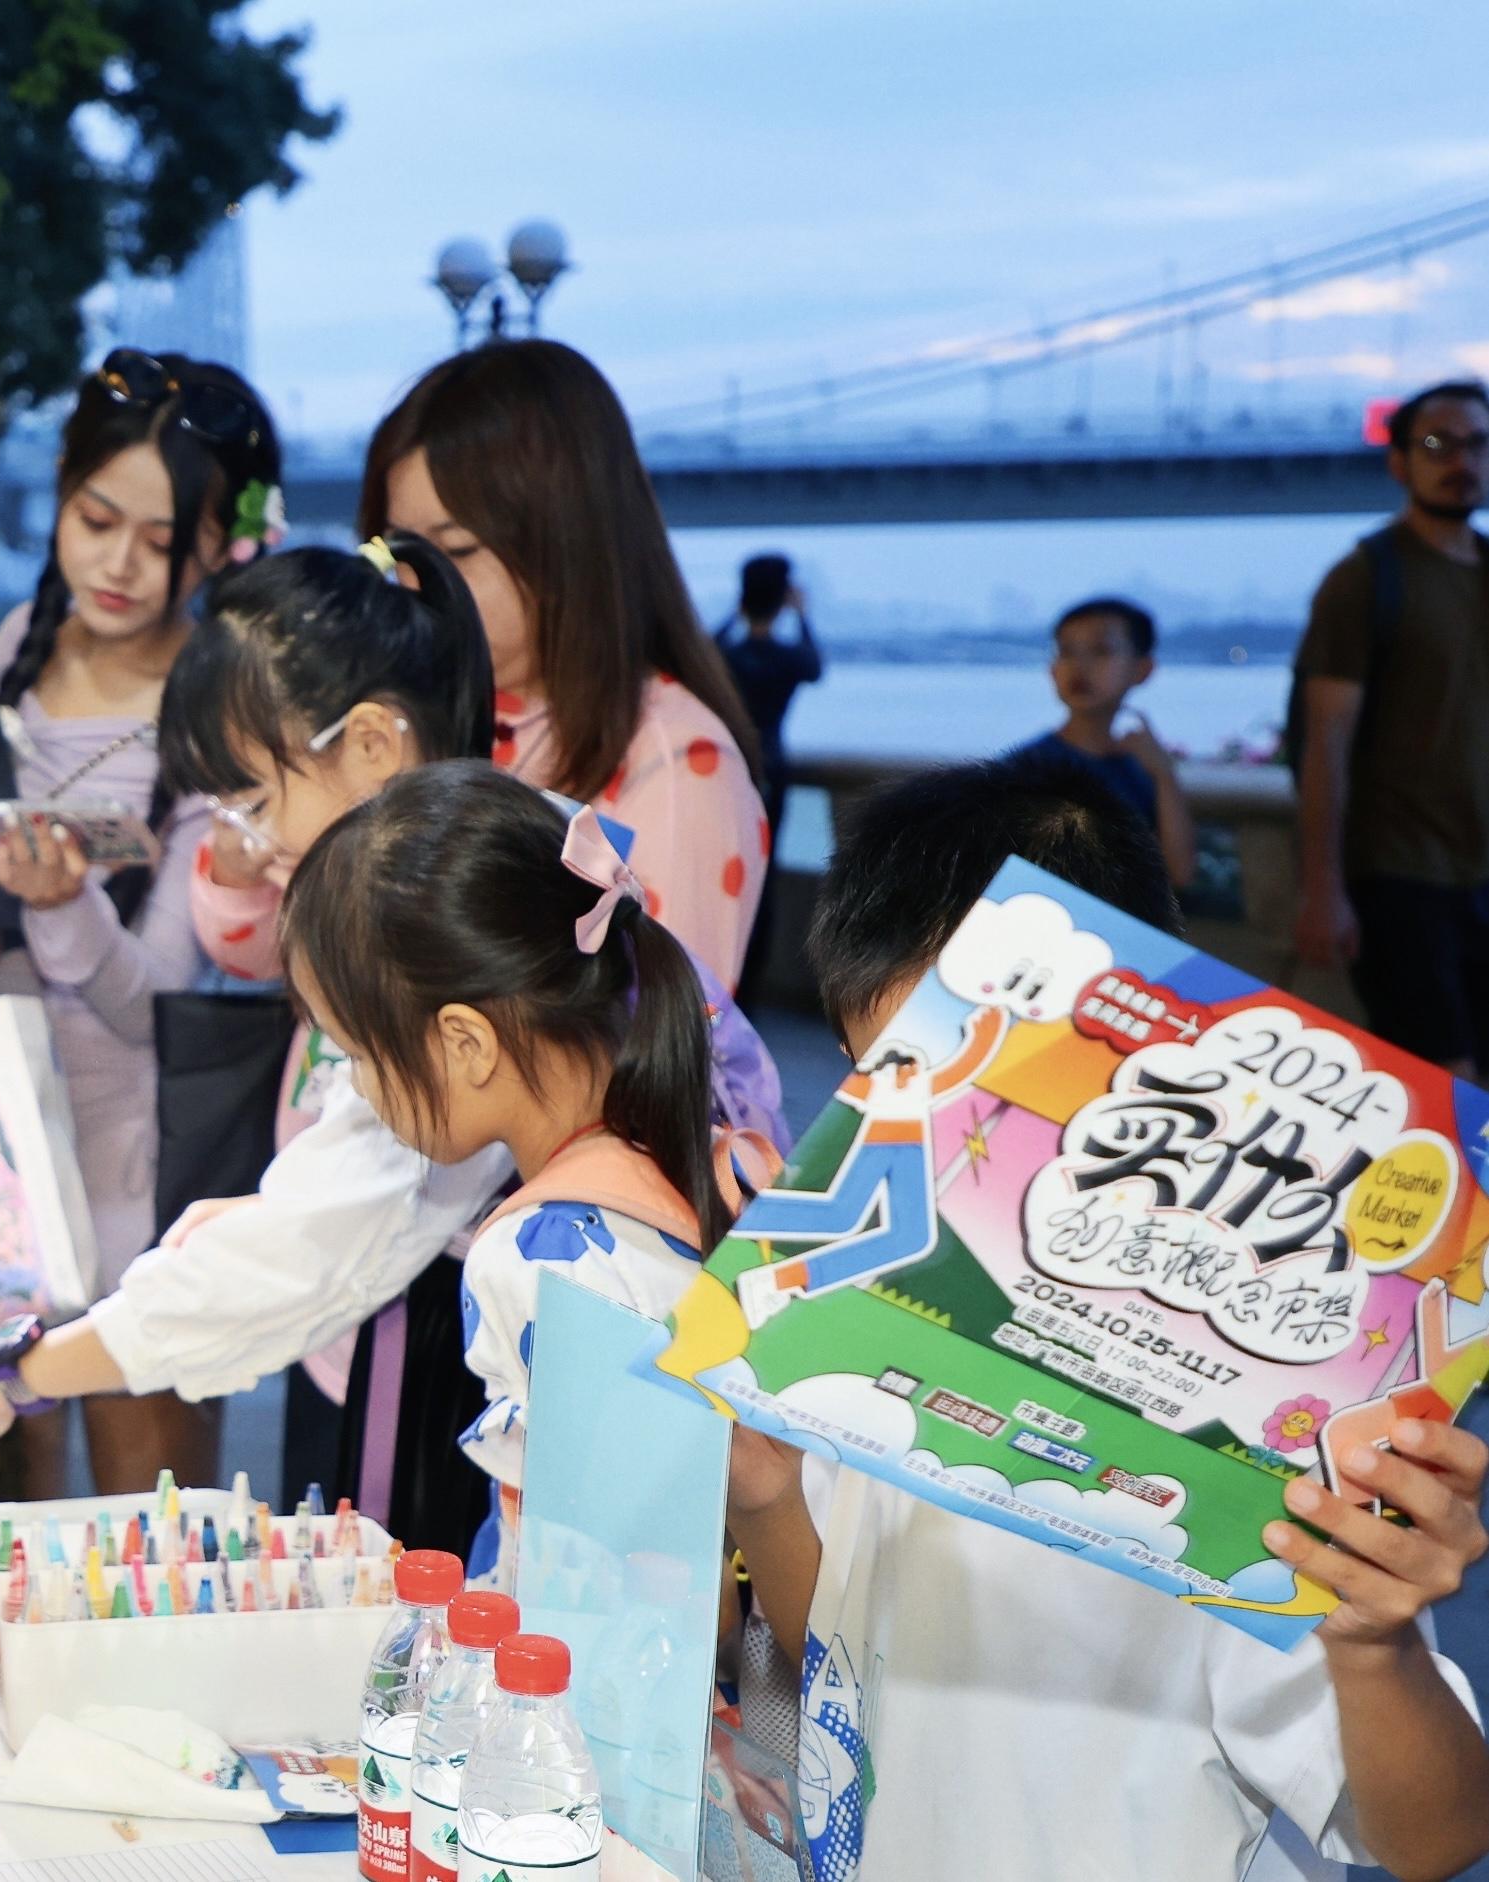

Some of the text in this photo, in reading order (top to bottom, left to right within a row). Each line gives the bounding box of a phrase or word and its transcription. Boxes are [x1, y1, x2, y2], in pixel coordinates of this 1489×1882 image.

[1376, 1158, 1442, 1196] Creative
[1357, 1192, 1424, 1228] Market
[1014, 1275, 1242, 1386] 2024.10.25-11.17
[373, 1843, 407, 1862] SPRING
